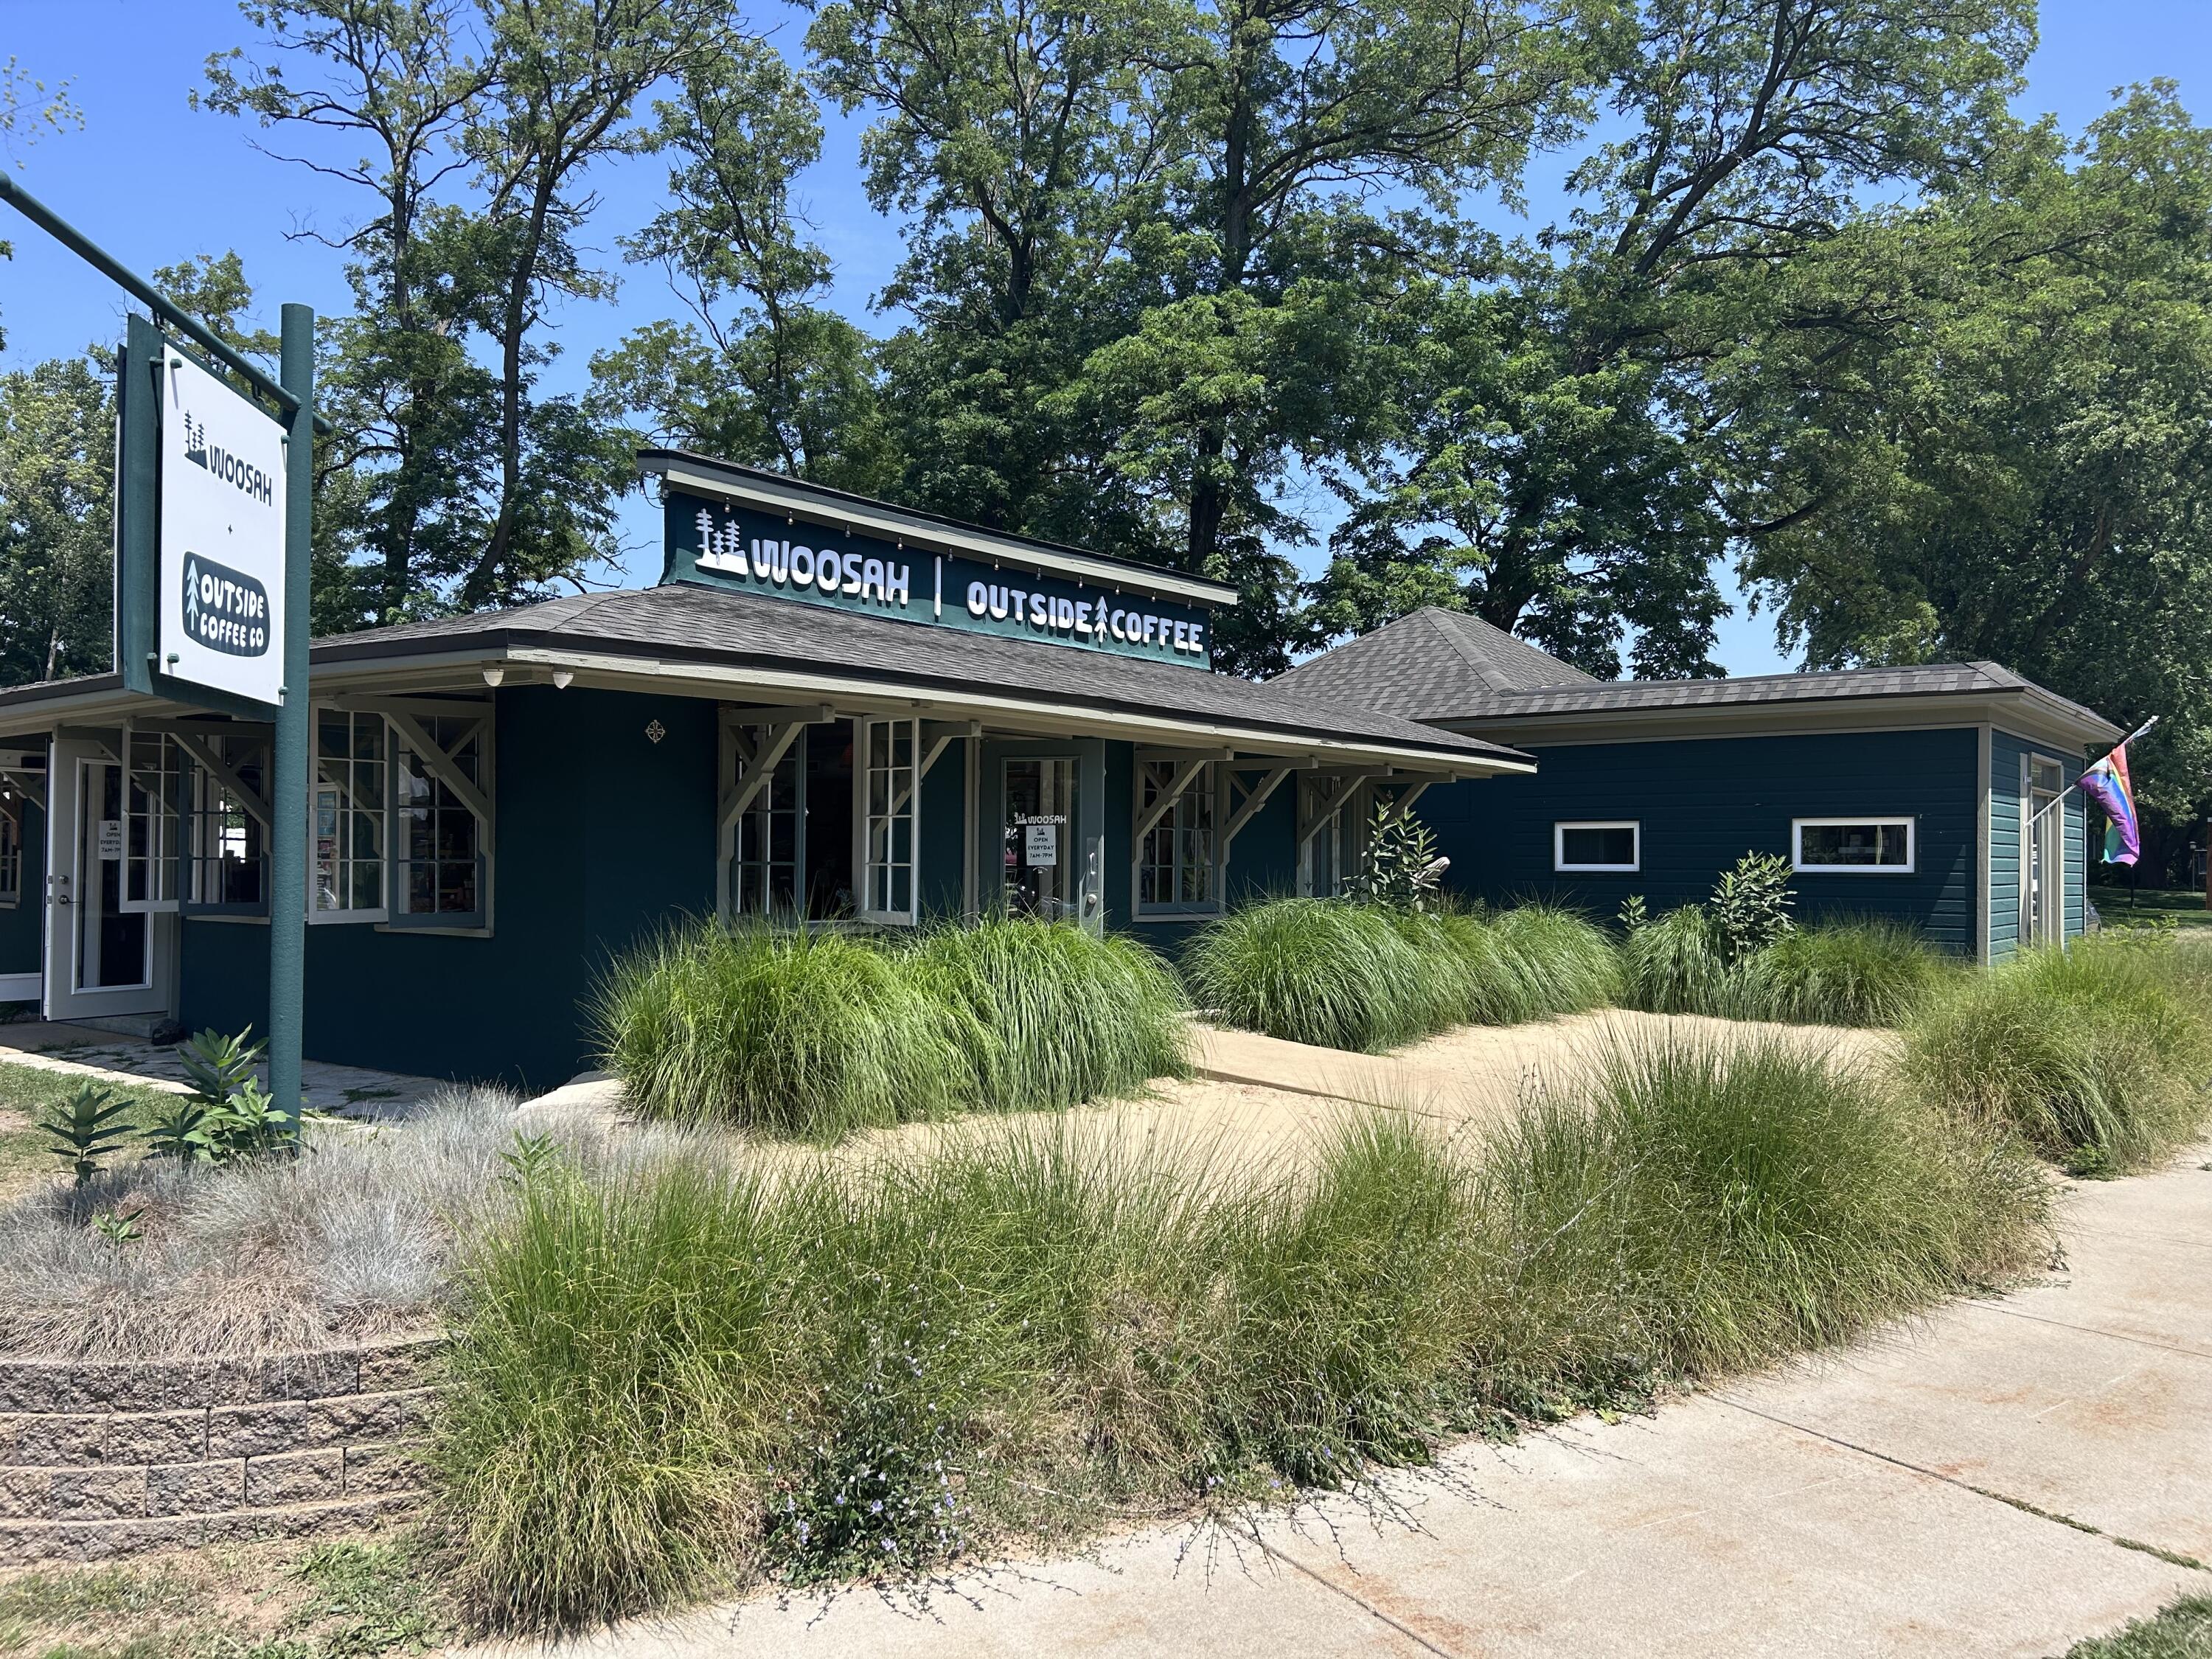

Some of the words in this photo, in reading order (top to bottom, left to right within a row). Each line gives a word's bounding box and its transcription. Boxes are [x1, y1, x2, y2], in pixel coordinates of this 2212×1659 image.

[209, 444, 272, 507] WOOSAH
[201, 574, 265, 619] OUTSIDE
[751, 538, 910, 605] WOOSAH
[967, 581, 1093, 633] OUTSIDE
[1110, 608, 1204, 653] COFFEE
[200, 612, 247, 647] COFFEE
[249, 627, 264, 647] CO
[1028, 815, 1067, 824] WOOSAH
